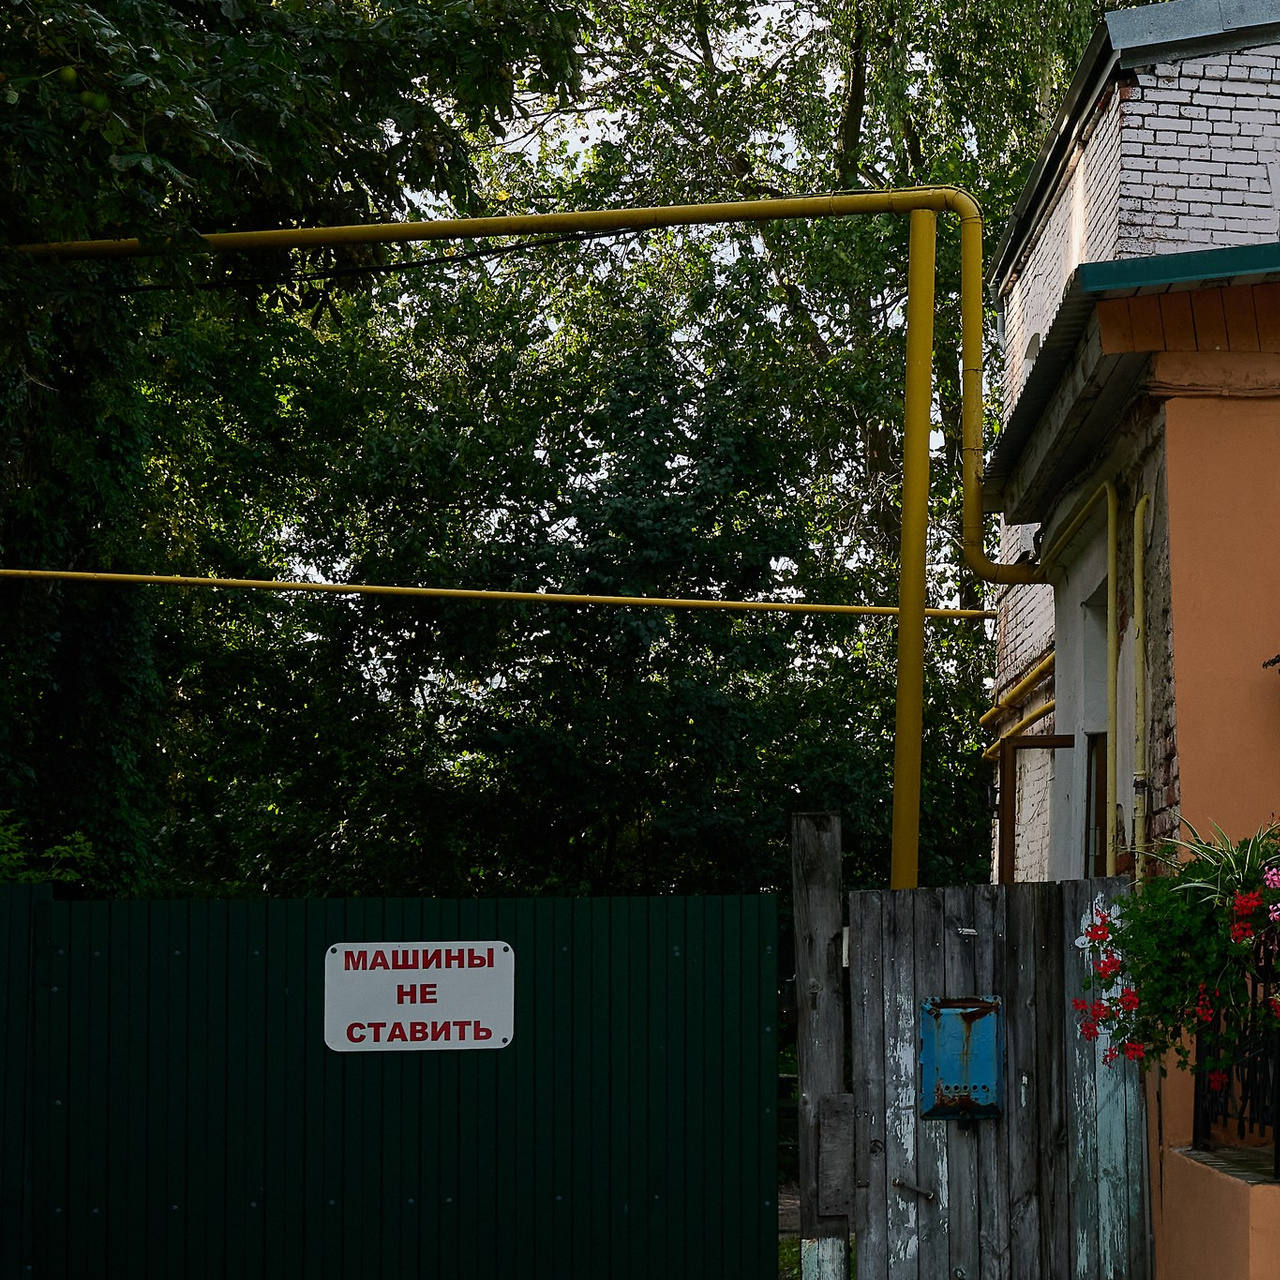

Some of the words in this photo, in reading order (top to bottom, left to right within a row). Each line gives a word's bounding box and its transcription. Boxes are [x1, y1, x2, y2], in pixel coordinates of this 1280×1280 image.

[344, 948, 494, 970] МАШИНЫ
[396, 984, 437, 1004] НЕ
[346, 1020, 493, 1043] СТАВИТЬ
